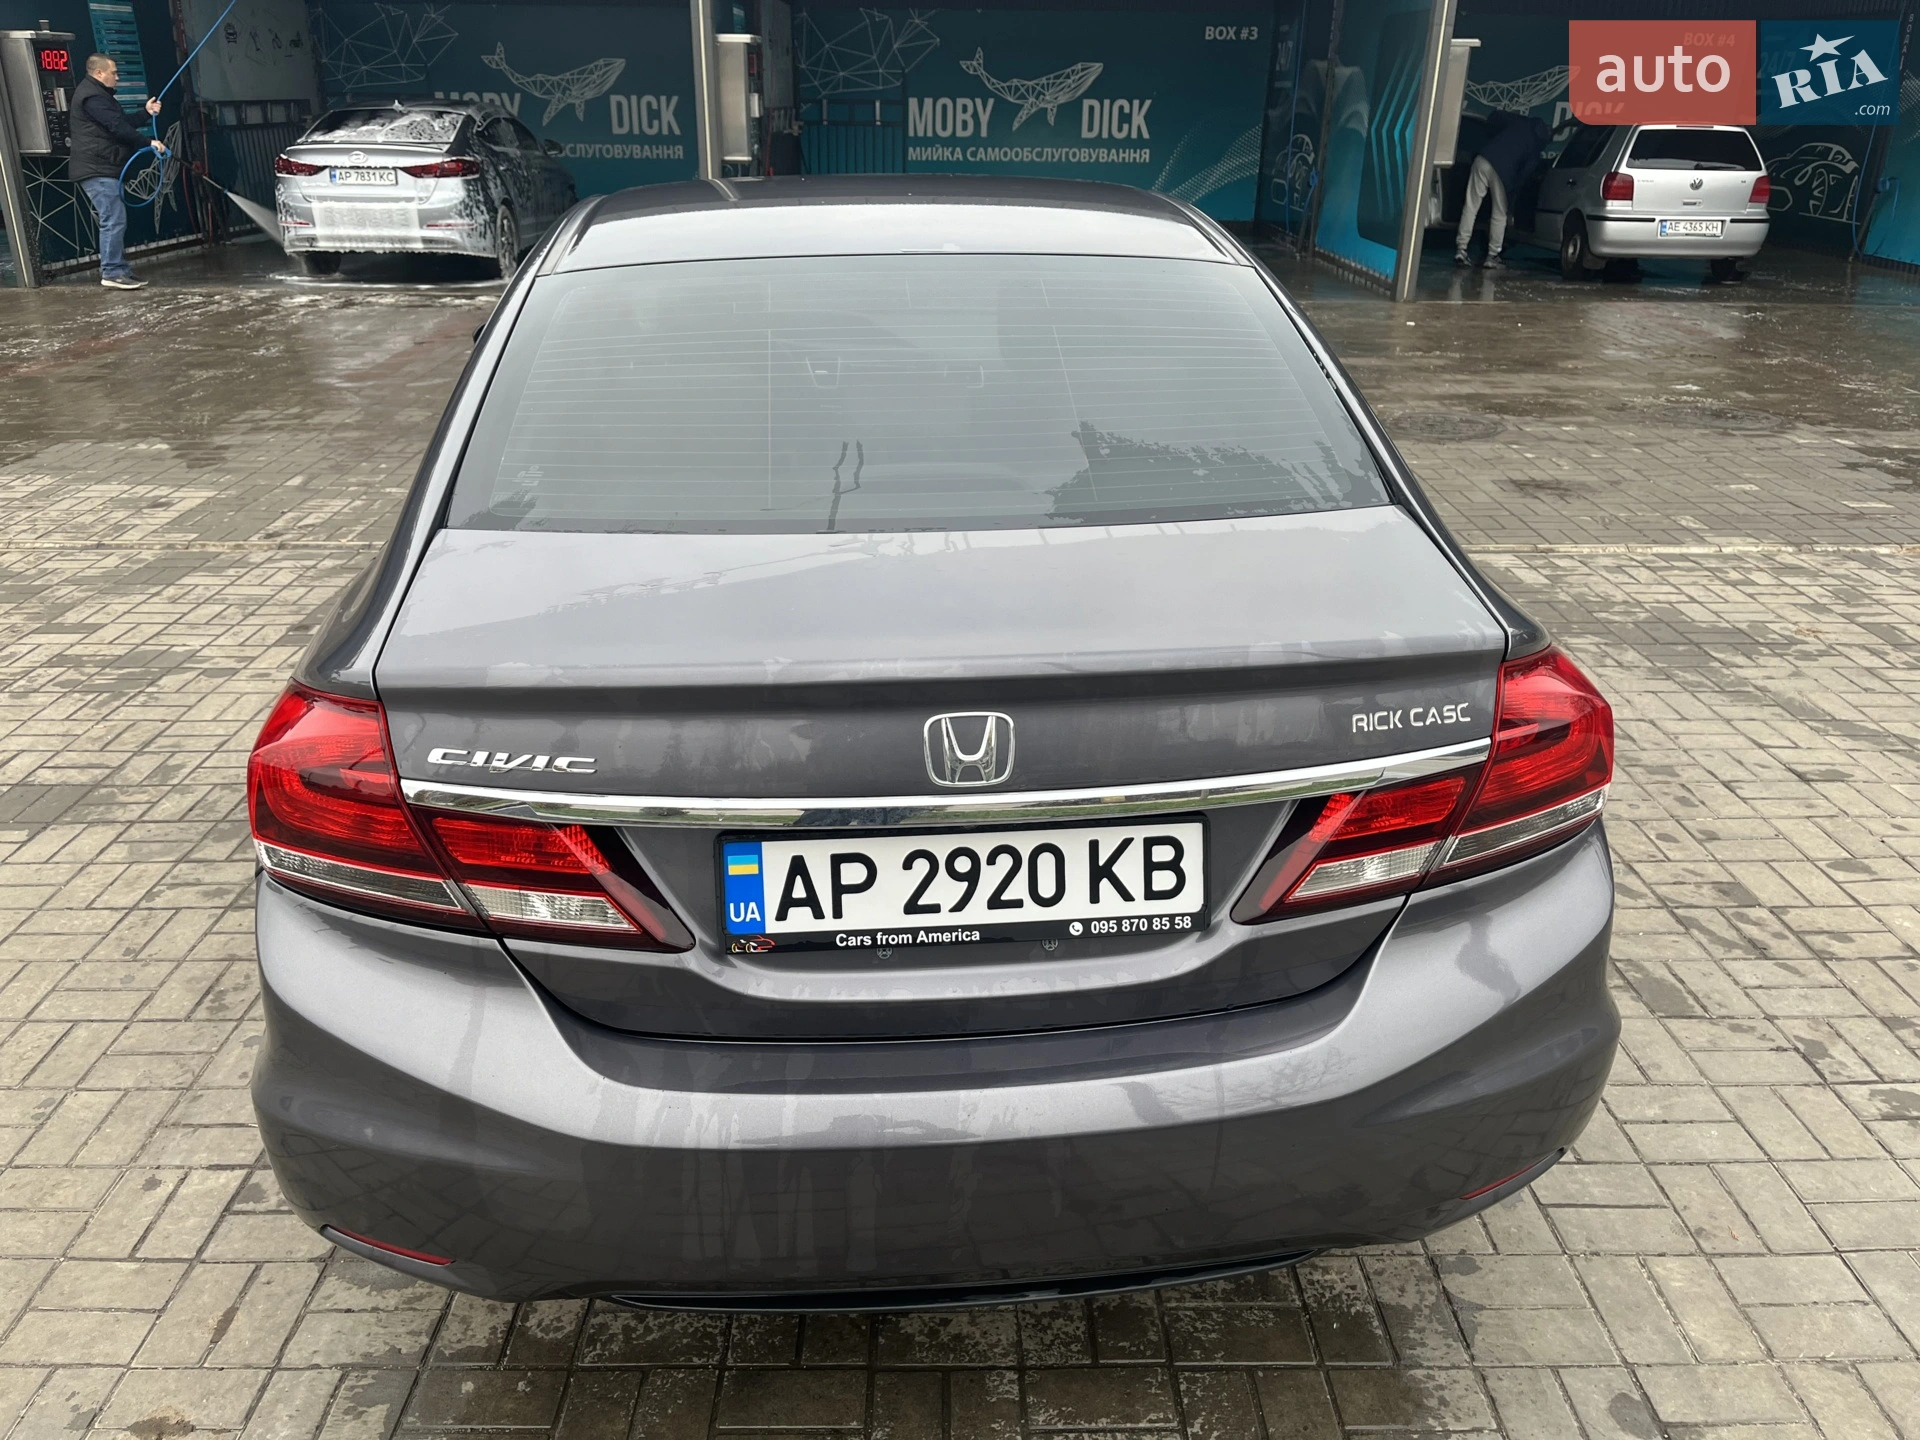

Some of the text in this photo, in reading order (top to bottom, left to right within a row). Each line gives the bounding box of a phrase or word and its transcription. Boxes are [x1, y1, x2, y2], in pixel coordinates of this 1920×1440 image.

[1205, 26, 1259, 40] BOX #3
[1683, 32, 1715, 46] BOX
[609, 94, 682, 136] DICK
[907, 97, 1152, 140] MOBY DICK
[907, 145, 1150, 163] МИЙКА САМООБСЛУГОВУВАННЯ
[338, 171, 394, 183] AP 7831 KC
[1668, 222, 1719, 232] AE 4365 KH
[1352, 709, 1403, 733] RICK
[427, 747, 597, 775] CIVIC
[774, 835, 1187, 922] AP 2920 KB
[729, 904, 762, 923] UA
[1090, 915, 1192, 935] 095 870 85 58
[835, 928, 981, 948] Cars from America
